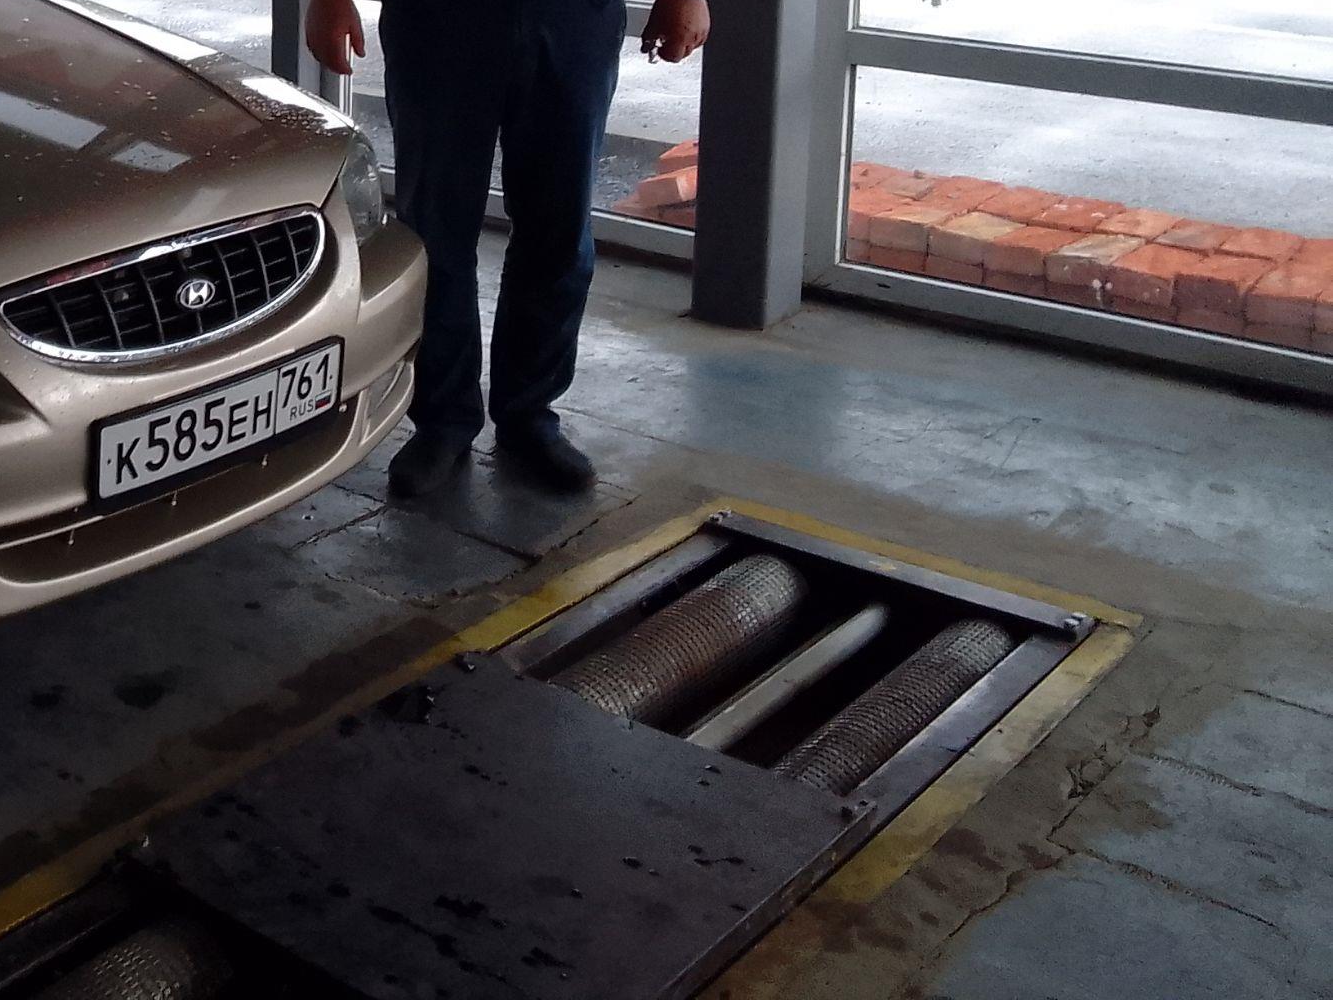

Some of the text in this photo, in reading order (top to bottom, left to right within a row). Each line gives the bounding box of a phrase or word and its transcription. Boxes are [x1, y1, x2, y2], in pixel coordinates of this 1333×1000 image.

[281, 353, 330, 409] 761
[116, 389, 273, 484] К585ЕН
[289, 402, 314, 421] RUS
